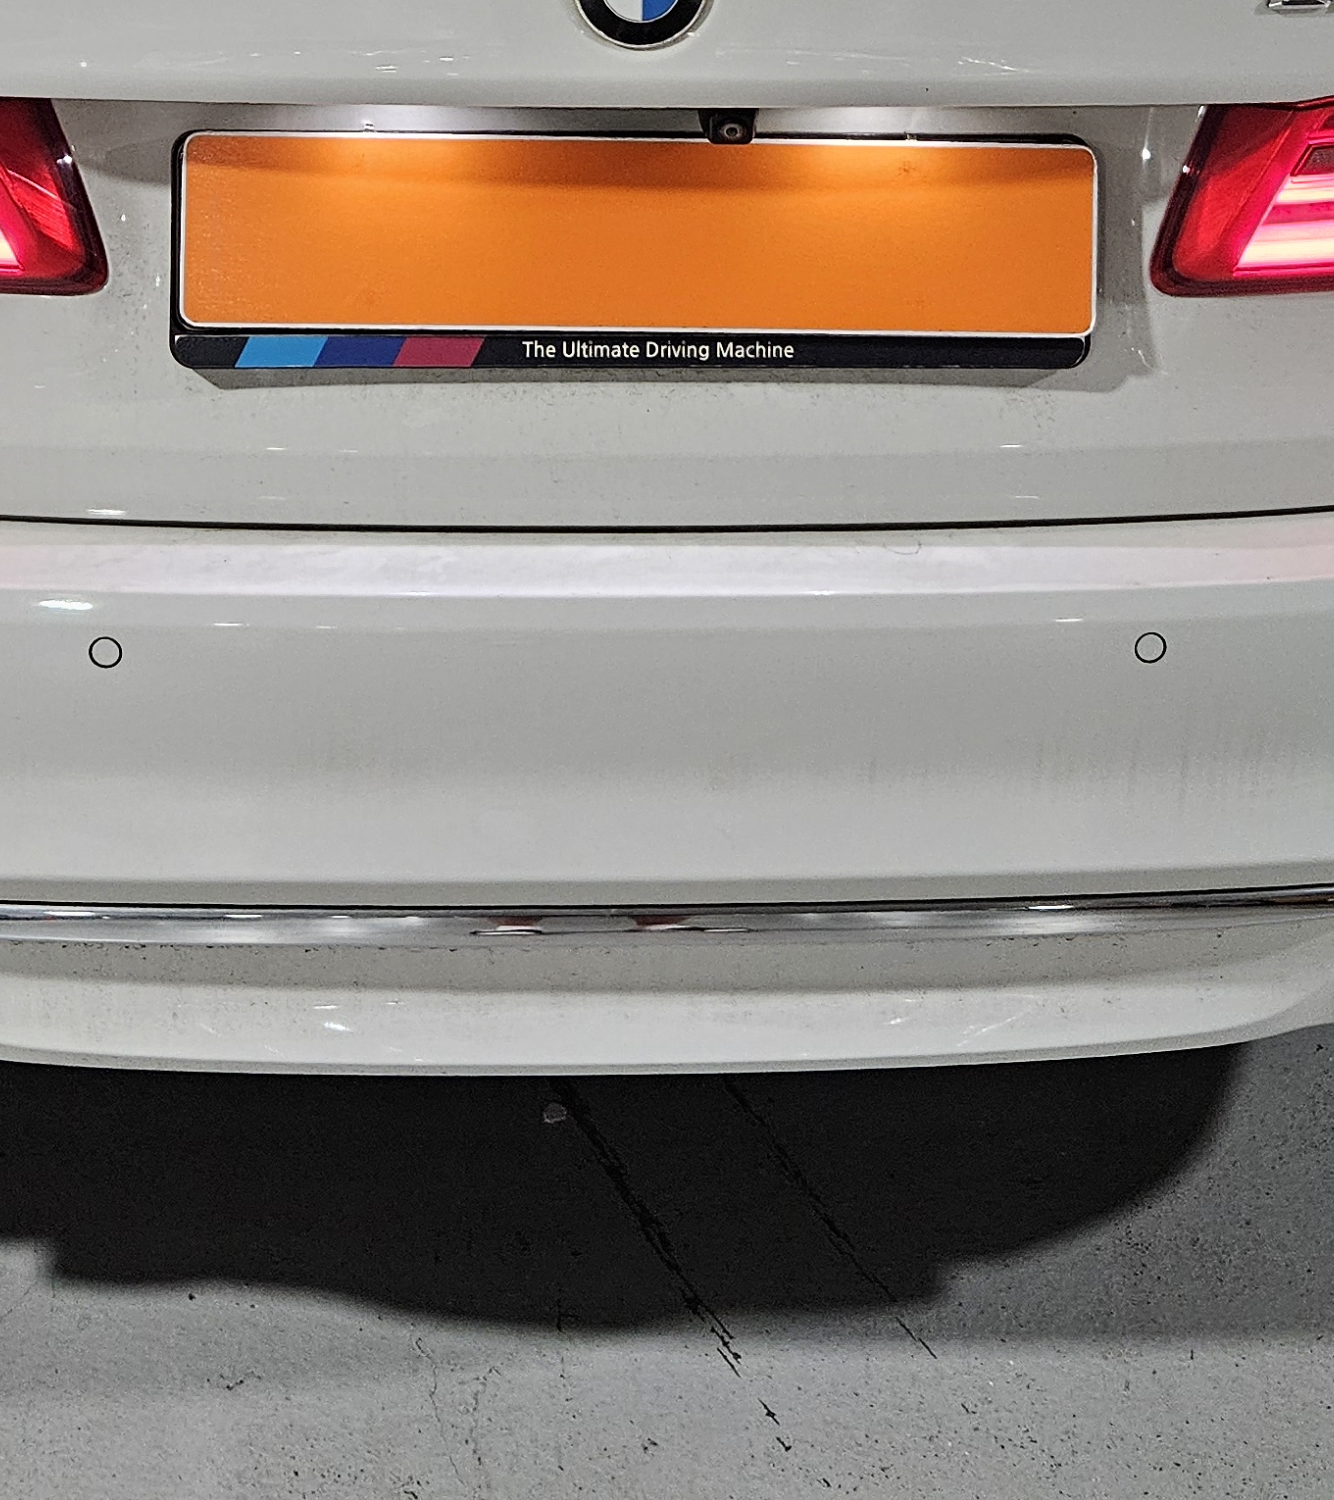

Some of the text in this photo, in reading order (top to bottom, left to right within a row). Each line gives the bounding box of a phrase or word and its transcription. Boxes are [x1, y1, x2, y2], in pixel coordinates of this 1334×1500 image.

[522, 339, 796, 361] The Ultimate Driving Machine
